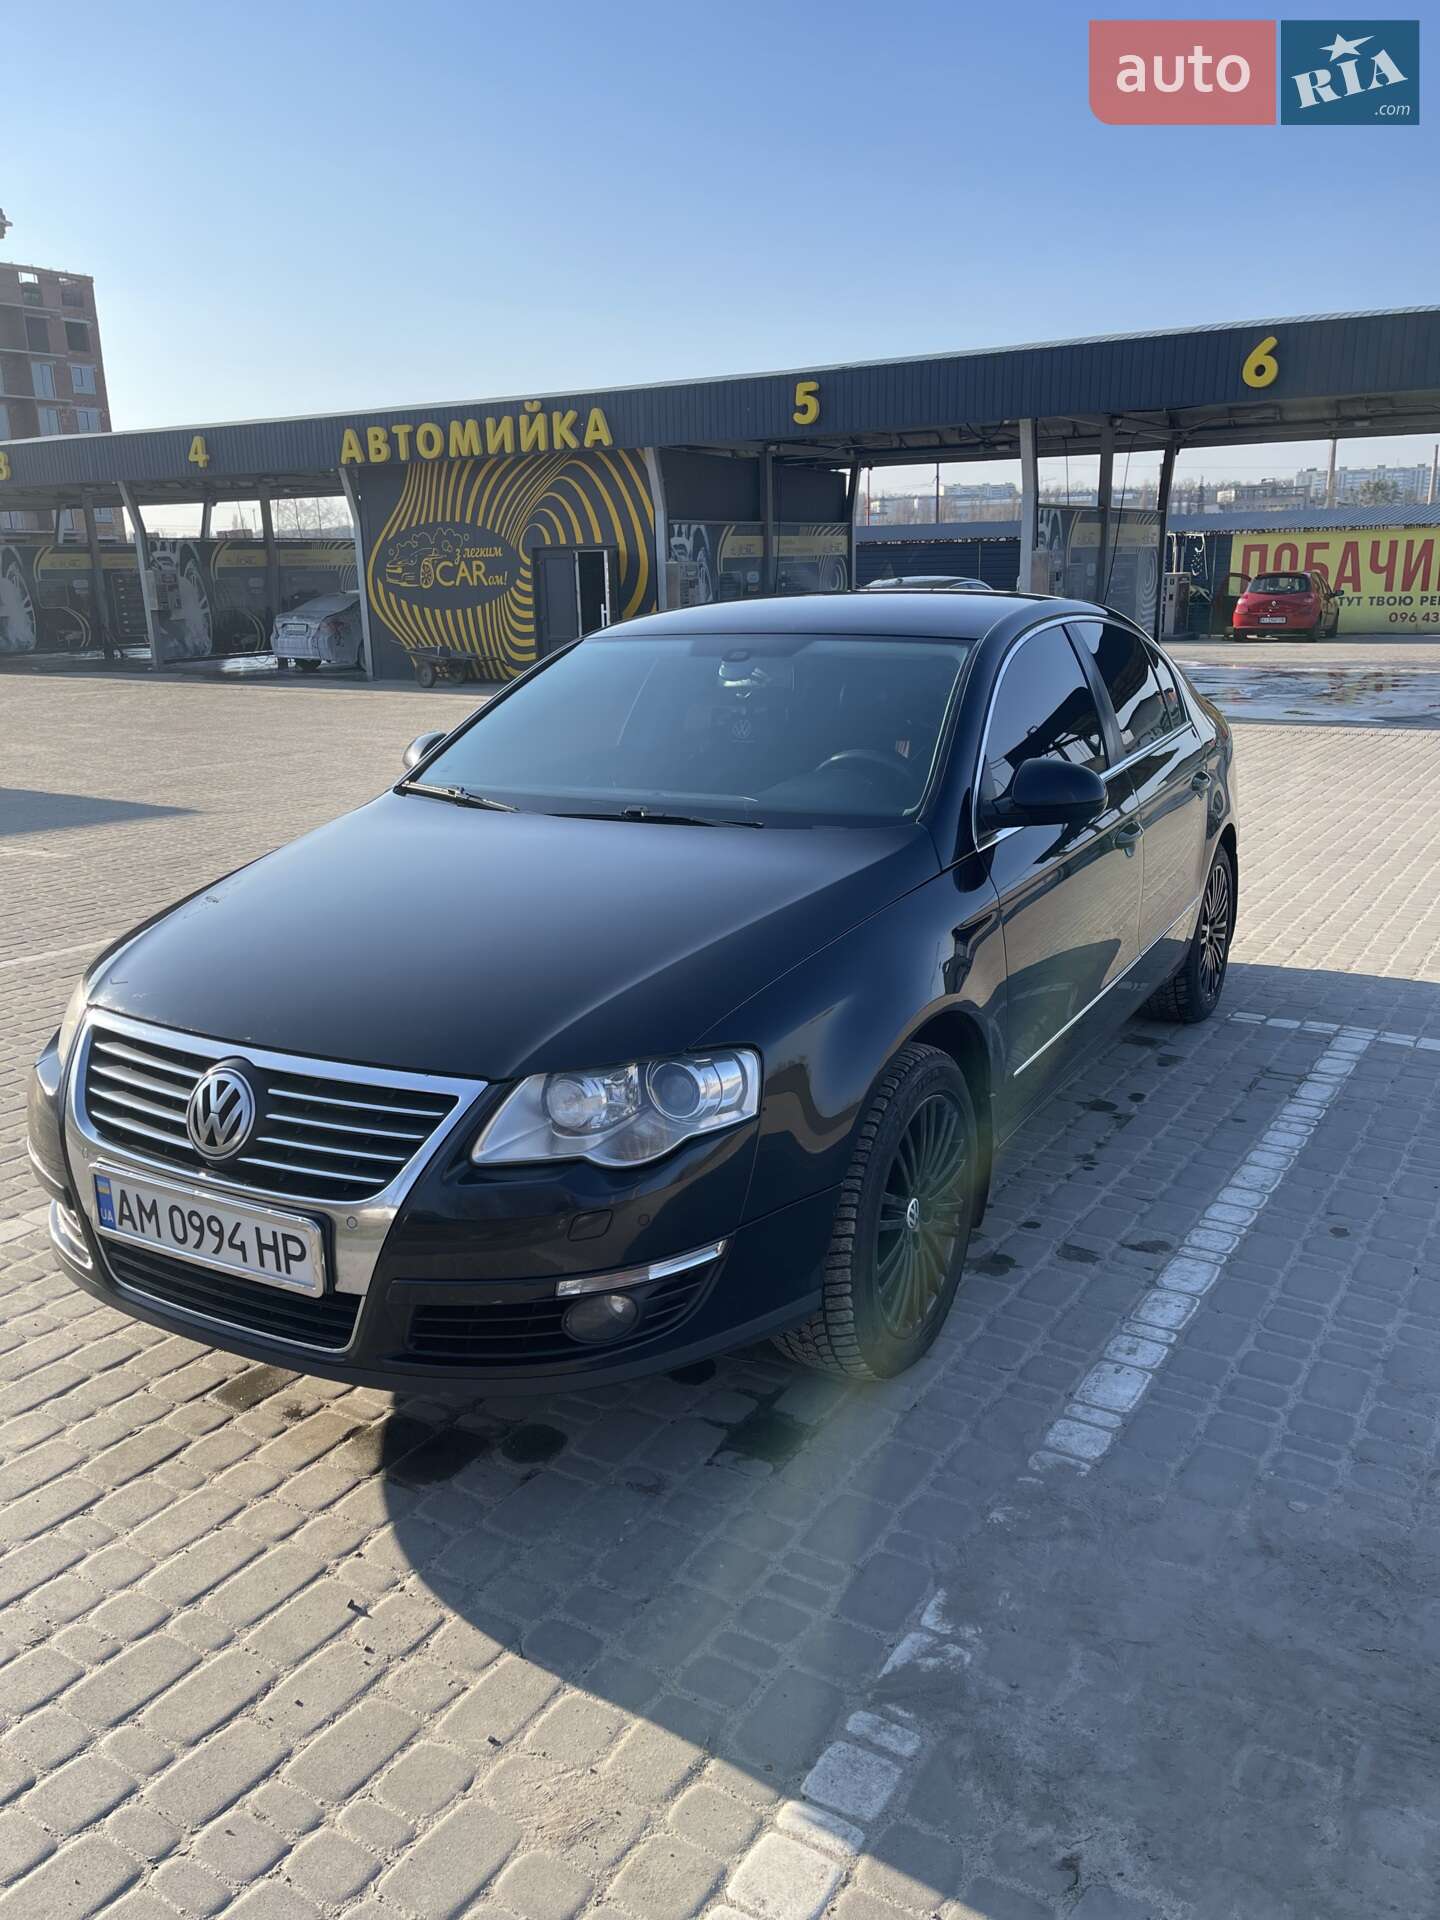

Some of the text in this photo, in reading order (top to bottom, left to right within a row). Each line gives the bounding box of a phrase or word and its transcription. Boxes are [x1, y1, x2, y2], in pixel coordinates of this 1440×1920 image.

[1241, 335, 1280, 389] 6
[793, 380, 821, 425] 5
[188, 434, 209, 468] 4
[339, 400, 614, 465] АВТОМИЙКА
[1240, 538, 1440, 595] ПОБАЧИ
[1338, 595, 1440, 606] ТУТ ТВОЮ РЕ
[1388, 611, 1440, 623] 096 43
[100, 1207, 115, 1223] UA
[118, 1189, 307, 1275] AM 0994 HP
